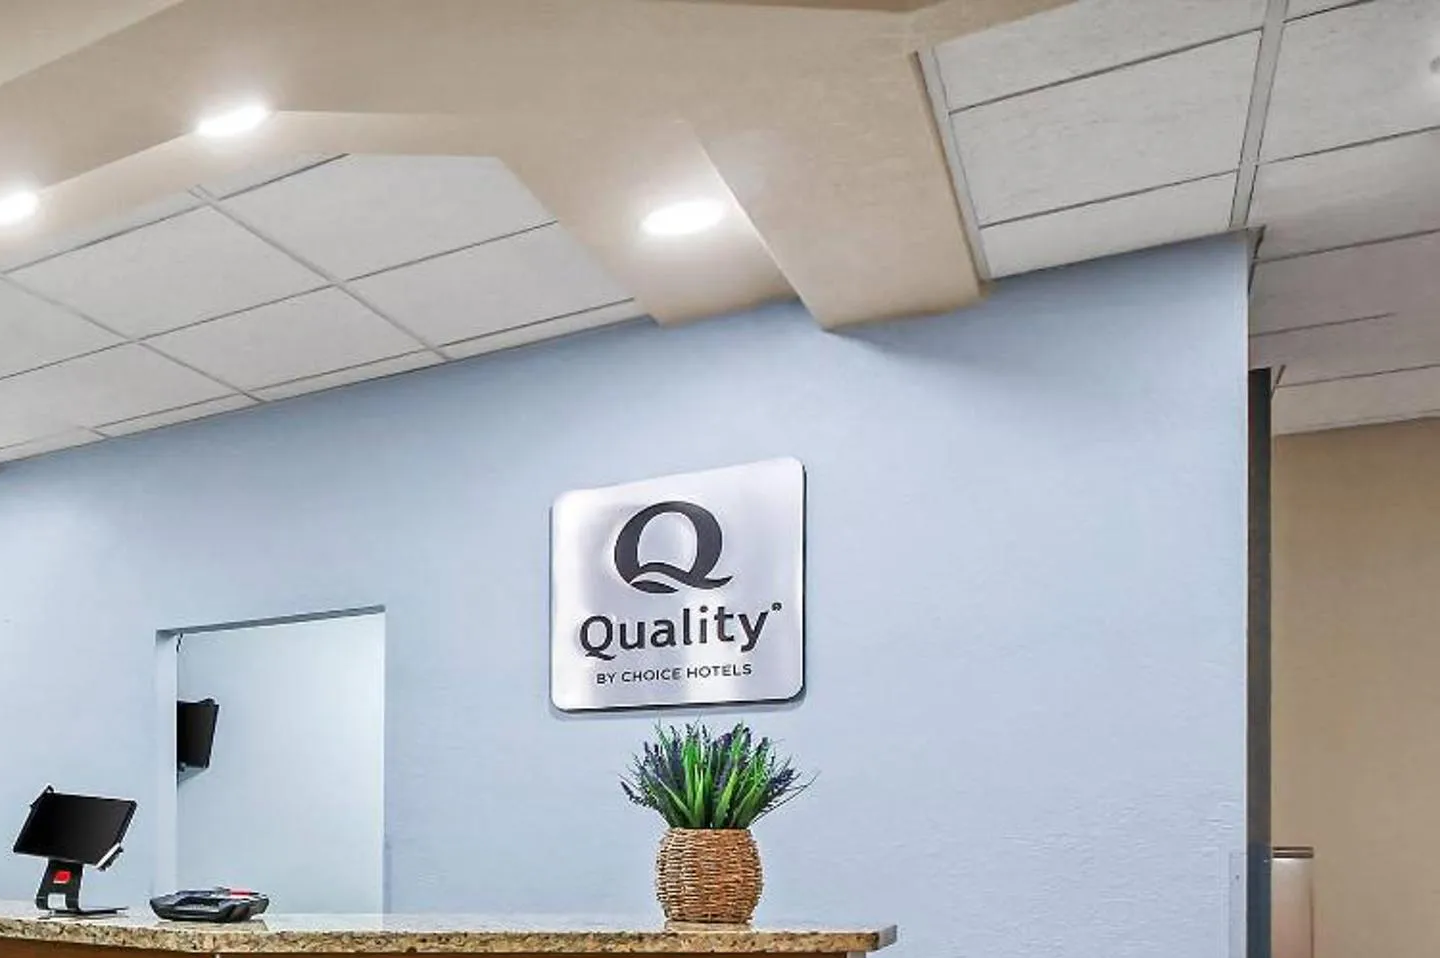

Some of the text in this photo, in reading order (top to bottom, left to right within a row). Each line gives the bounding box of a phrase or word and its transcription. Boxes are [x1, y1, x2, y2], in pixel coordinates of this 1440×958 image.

[614, 500, 734, 594] Q
[579, 605, 770, 661] Quality
[596, 663, 753, 684] BY CHOICE HOTELS
